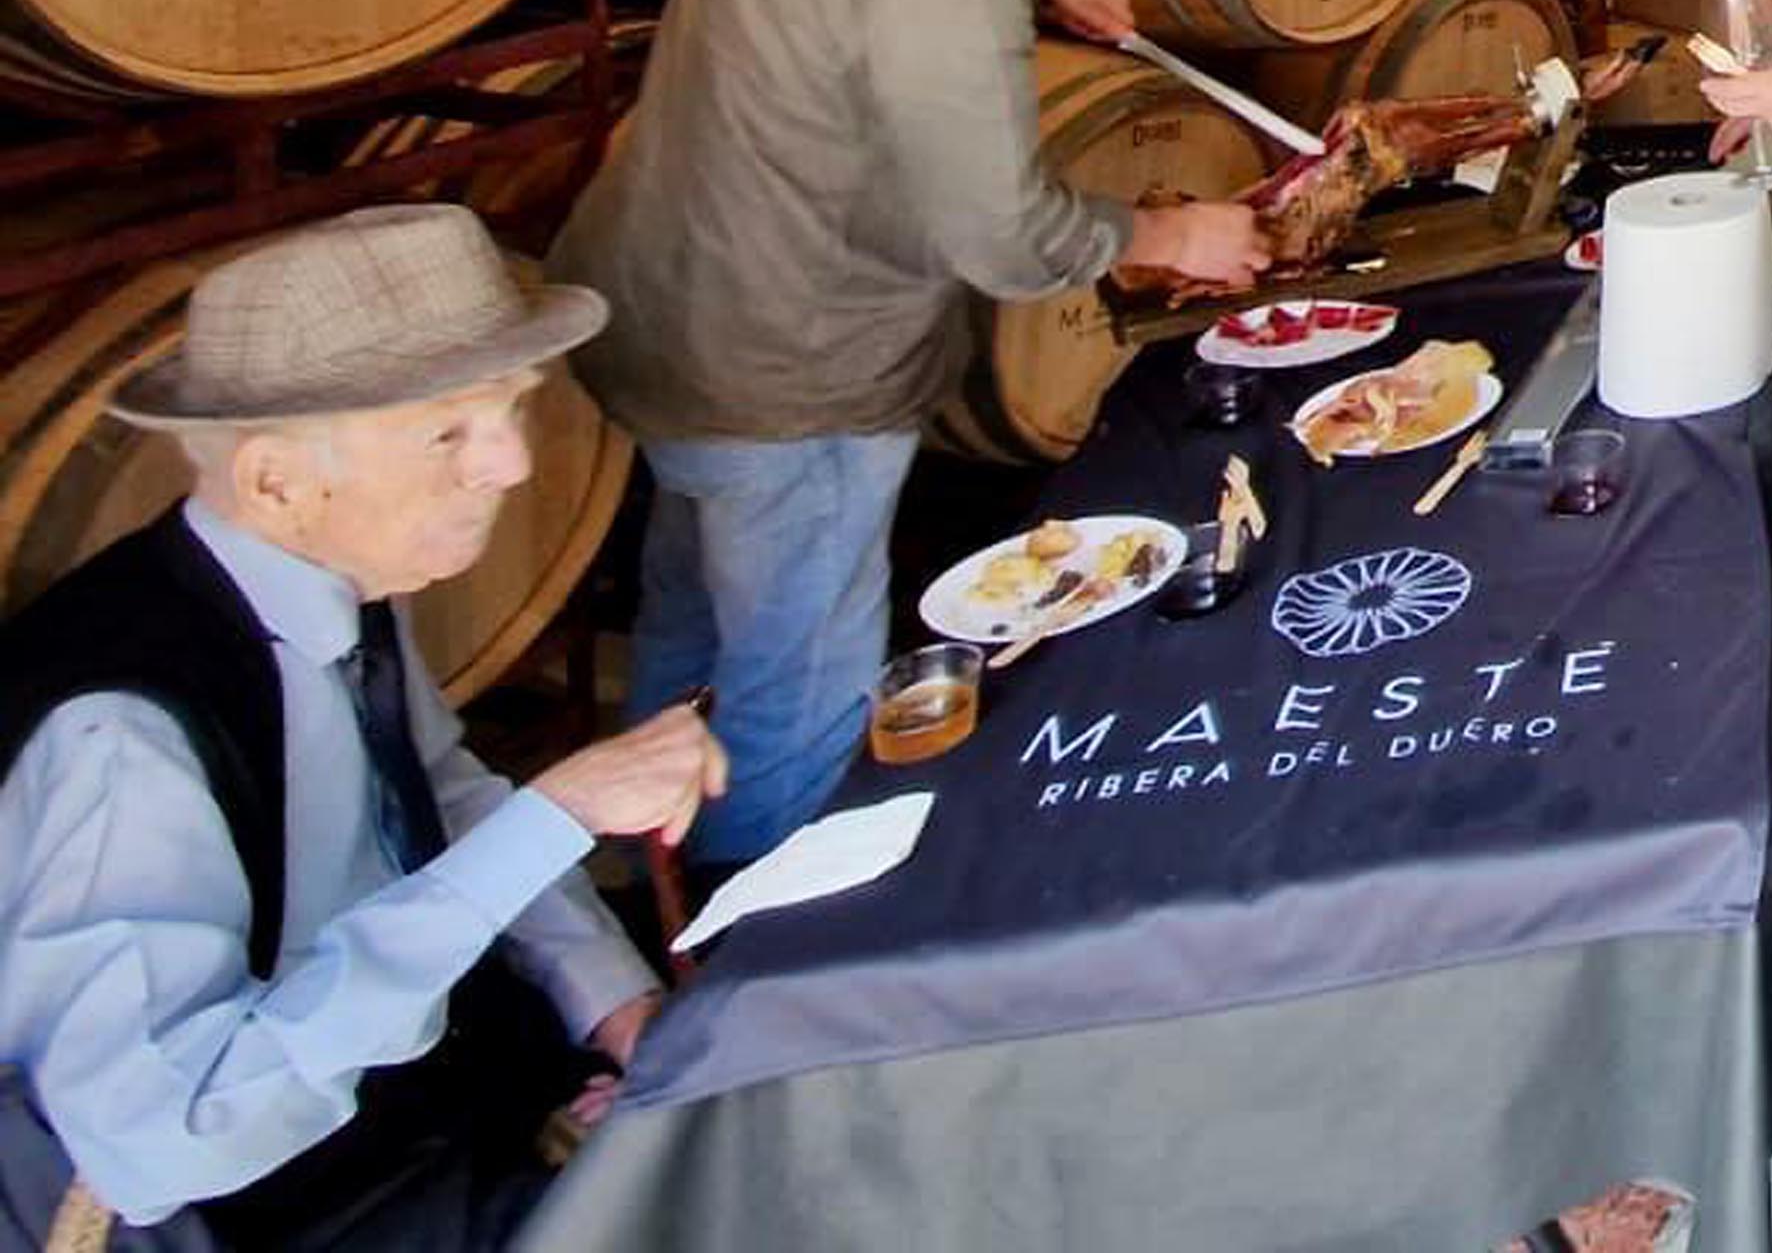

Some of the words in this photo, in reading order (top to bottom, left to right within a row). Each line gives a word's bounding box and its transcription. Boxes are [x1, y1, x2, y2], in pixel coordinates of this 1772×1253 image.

[1020, 647, 1614, 763] MAESTE
[1038, 761, 1231, 808] RIBERA
[1268, 742, 1353, 777] DEL
[1387, 716, 1558, 759] DUERO
